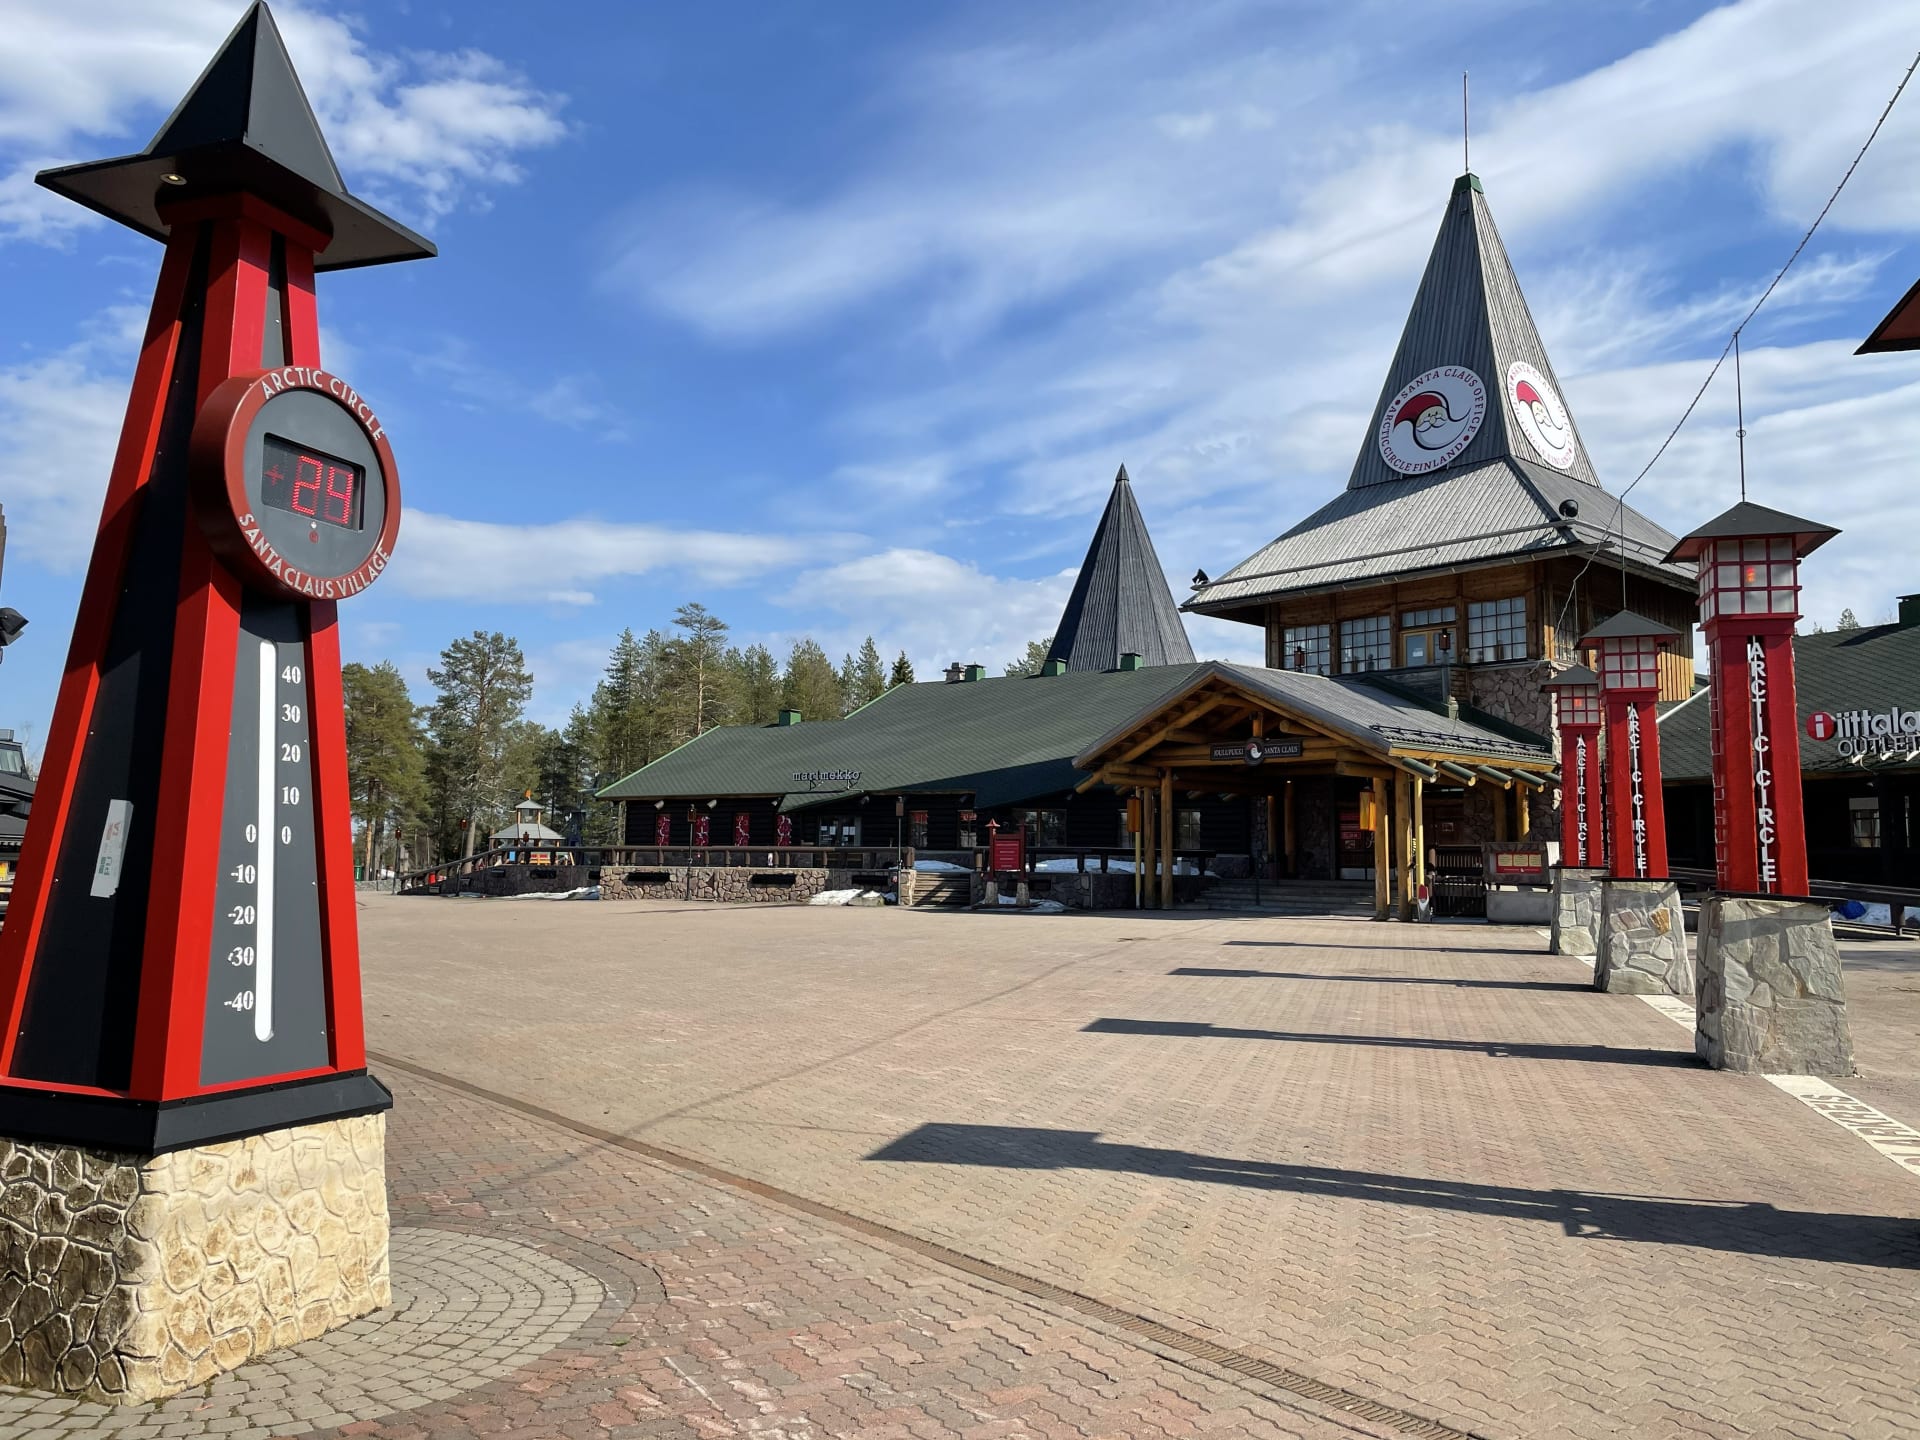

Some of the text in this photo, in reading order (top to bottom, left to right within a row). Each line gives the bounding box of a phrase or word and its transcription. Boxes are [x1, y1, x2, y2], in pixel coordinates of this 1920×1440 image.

[261, 367, 385, 441] ARCTIC CIRCLE
[1401, 368, 1484, 433] SANTA CLAUS OFFICE
[1381, 406, 1463, 472] ARCTIC CIRCLE FINLAND
[240, 513, 390, 599] SANTA CLAUS VILLAGE
[281, 665, 301, 684] 40
[281, 704, 301, 723] 30
[1836, 706, 1920, 738] iittala
[281, 743, 301, 763] 20
[1838, 735, 1920, 757] OUTLET
[1750, 642, 1777, 882] ARCTIC CIRCLE
[792, 768, 860, 781] marimekko
[281, 786, 300, 805] 10
[1628, 706, 1647, 869] ARCTIC CIRCLE
[1576, 737, 1588, 861] ARCTIC CIRCLE
[245, 823, 257, 843] 0
[281, 825, 292, 844] 0
[230, 864, 256, 884] -10
[228, 905, 255, 925] -20
[224, 990, 254, 1012] -40
